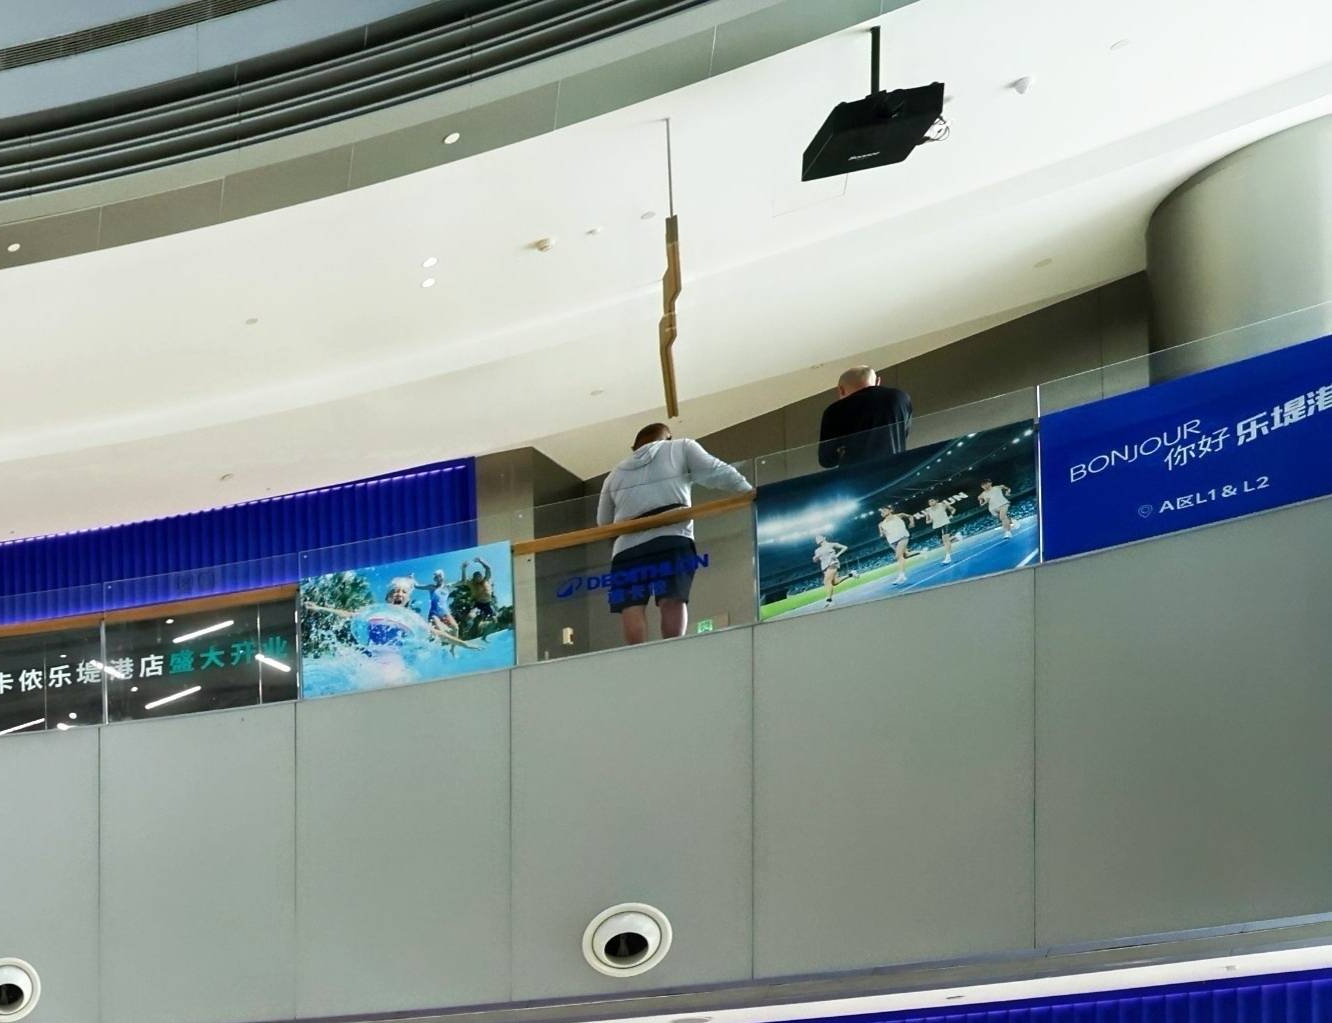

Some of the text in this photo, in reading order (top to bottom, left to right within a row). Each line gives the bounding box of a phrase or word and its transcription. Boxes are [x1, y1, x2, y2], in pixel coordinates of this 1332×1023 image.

[1069, 418, 1202, 483] BONJOUR
[1164, 426, 1230, 472] 你好
[1243, 475, 1271, 494] L2
